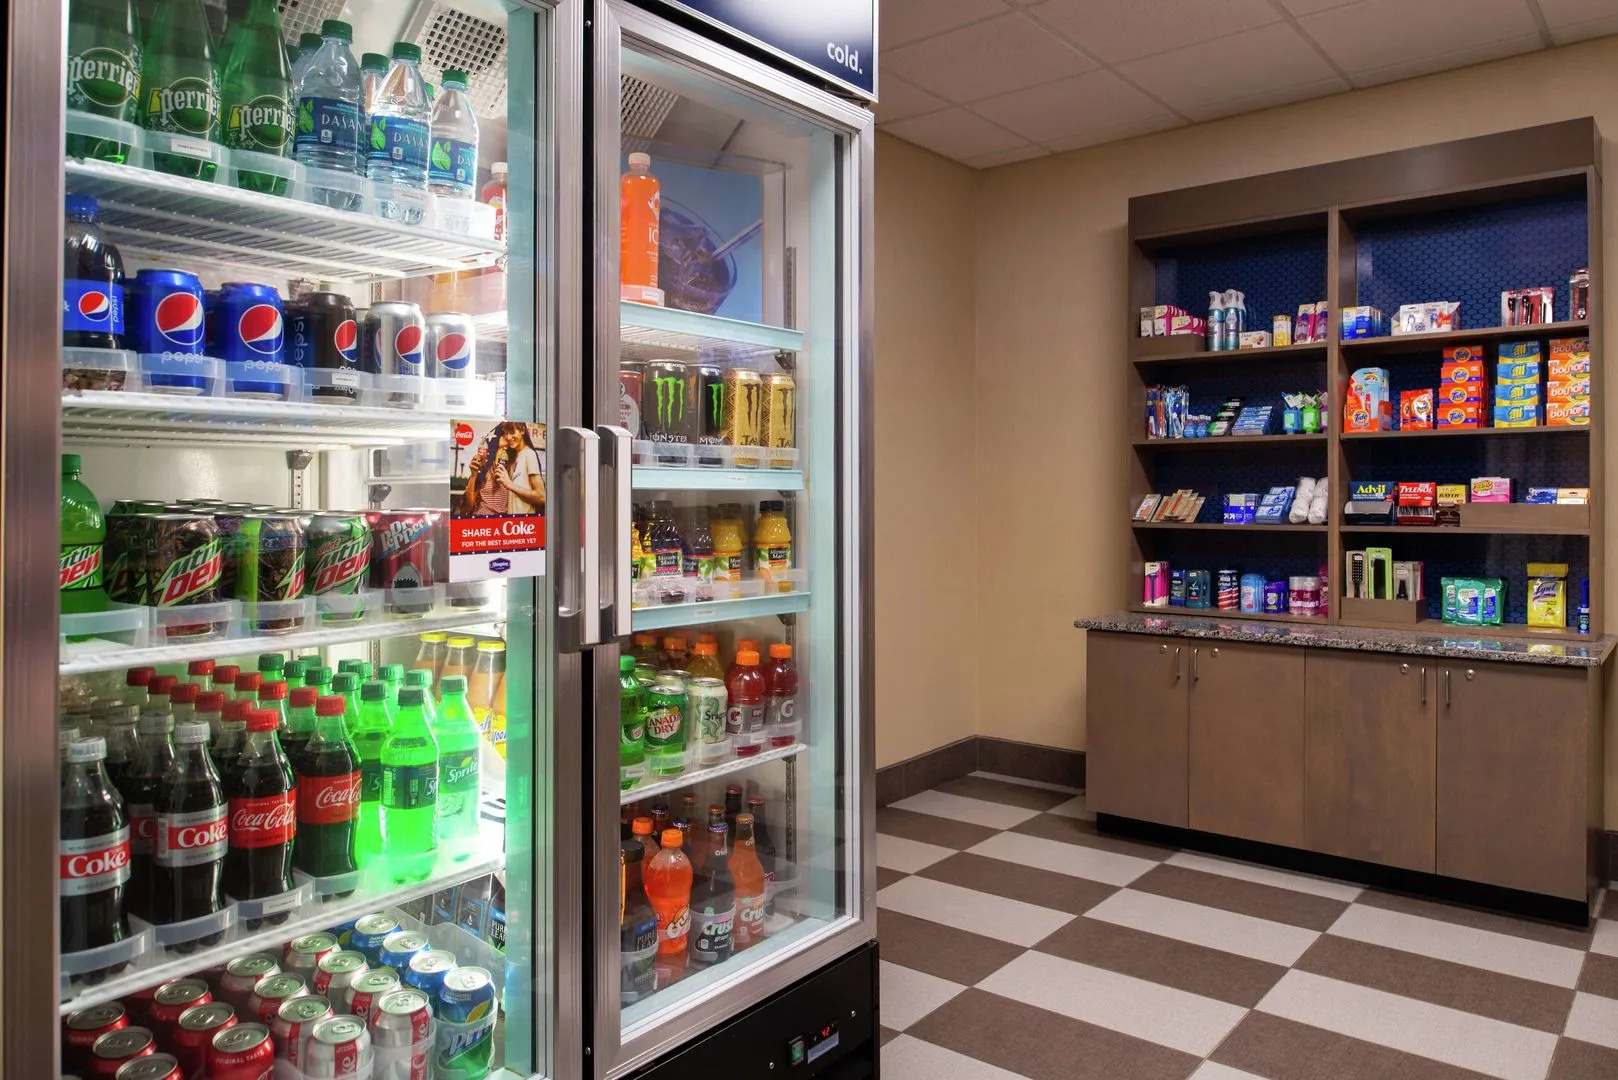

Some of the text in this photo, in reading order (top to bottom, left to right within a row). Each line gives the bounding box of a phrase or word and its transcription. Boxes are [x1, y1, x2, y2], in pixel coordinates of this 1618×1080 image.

[827, 42, 863, 75] cold.
[321, 113, 365, 133] DASAN
[1453, 371, 1468, 380] Tide
[1511, 365, 1526, 377] all
[1452, 391, 1466, 400] Tide
[1510, 386, 1524, 398] all
[1353, 413, 1368, 422] Tide
[1449, 412, 1464, 421] Tide
[1509, 407, 1523, 419] all
[1356, 484, 1386, 494] Advil
[462, 521, 536, 537] SHARE A Coke
[1535, 583, 1557, 595] Lysol
[654, 723, 674, 735] DRY
[177, 823, 227, 847] Coke
[68, 850, 126, 877] Coke
[702, 921, 733, 935] Crus
